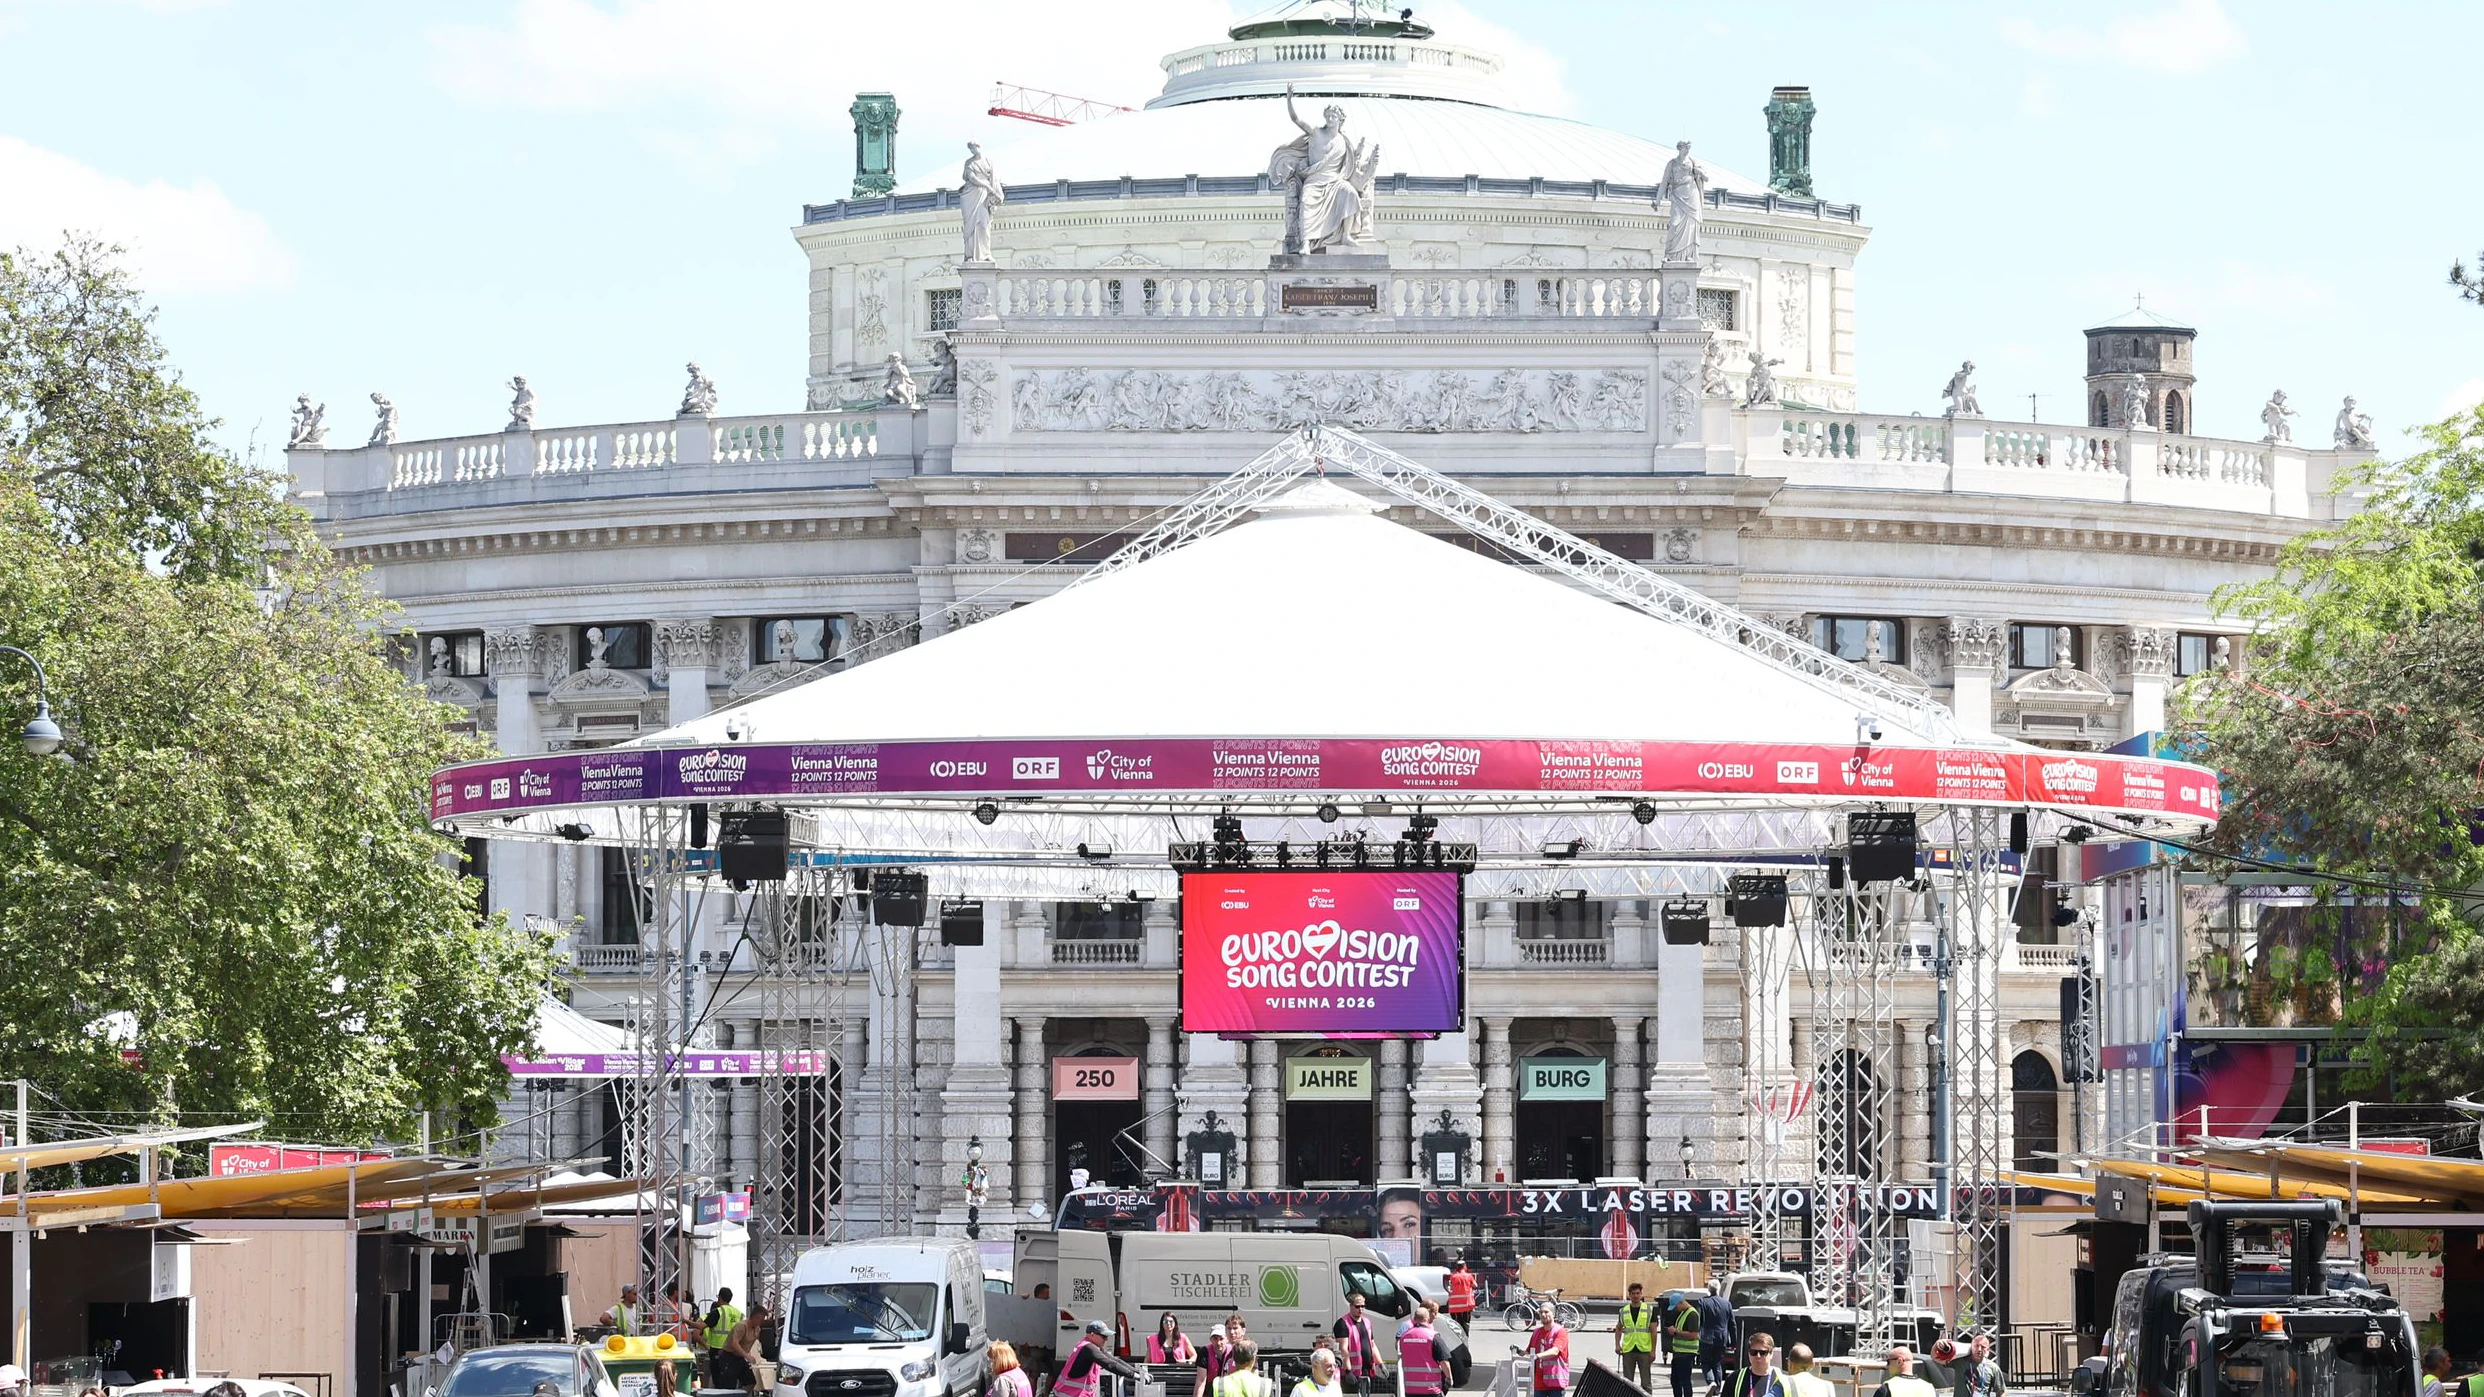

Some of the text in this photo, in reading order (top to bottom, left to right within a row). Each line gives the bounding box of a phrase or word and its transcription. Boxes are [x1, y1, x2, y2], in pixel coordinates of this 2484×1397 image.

[792, 756, 878, 769] Vienna Vienna
[1111, 756, 1152, 770] City of
[1213, 751, 1320, 764] Vienna Vienna
[1540, 752, 1642, 767] Vienna Vienna
[581, 765, 642, 779] Vienna Vienna
[958, 762, 986, 776] EBU
[1016, 762, 1056, 774] ORF
[1111, 769, 1153, 780] Vienna
[1213, 768, 1320, 777] 12 POINTS 12 POINTS
[1384, 762, 1478, 775] SONG CONTEST
[1540, 769, 1642, 779] 12 POINTS 12 POINTS
[1725, 764, 1754, 778] EBU
[1781, 766, 1814, 778] ORF
[1861, 763, 1894, 776] City of
[1936, 762, 2006, 778] Vienna Vienna
[530, 773, 550, 787] City of
[681, 770, 744, 783] SONG CONTEST
[792, 771, 878, 782] 12 POINTS 12 POINTS
[1861, 776, 1894, 787] Vienna
[492, 783, 508, 795] ORF
[581, 778, 643, 790] 12 POINTS 12 POINTS
[1936, 778, 2006, 790] 12 POINTS 12 POINTS
[530, 787, 551, 797] Vienna
[1227, 960, 1415, 988] SONG CONTEST
[1266, 997, 1375, 1009] VIENNA 2026
[1075, 1071, 1115, 1088] 250
[1299, 1071, 1358, 1088] JAHRE
[1536, 1070, 1590, 1088] BURG
[239, 1159, 270, 1168] City of
[1522, 1191, 1562, 1212] 3X
[1582, 1191, 1692, 1212] LASER
[851, 1265, 874, 1273] holz
[1170, 1273, 1250, 1286] STADLER
[1172, 1287, 1251, 1298] TISCHLEREI
